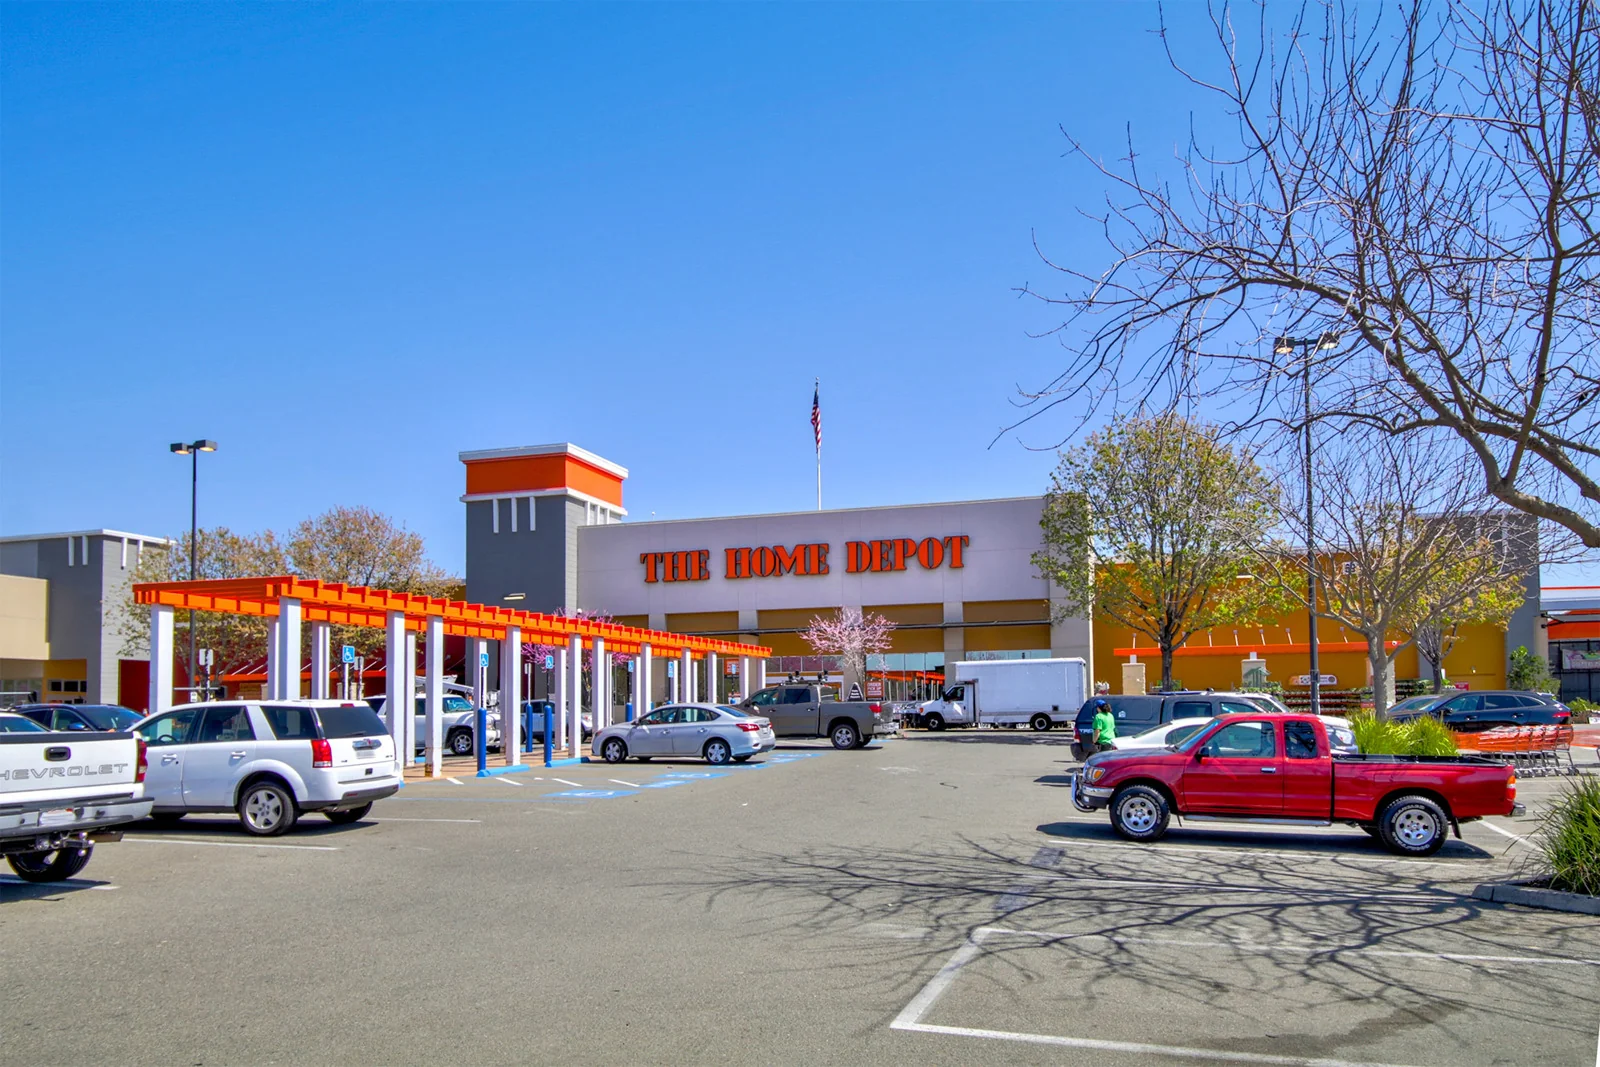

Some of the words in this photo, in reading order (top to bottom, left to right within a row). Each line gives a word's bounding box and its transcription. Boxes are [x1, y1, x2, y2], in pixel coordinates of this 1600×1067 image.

[640, 549, 710, 583] THE
[724, 543, 829, 579] HOME
[845, 535, 969, 573] DEPOT
[0, 763, 128, 780] HEVROLET
